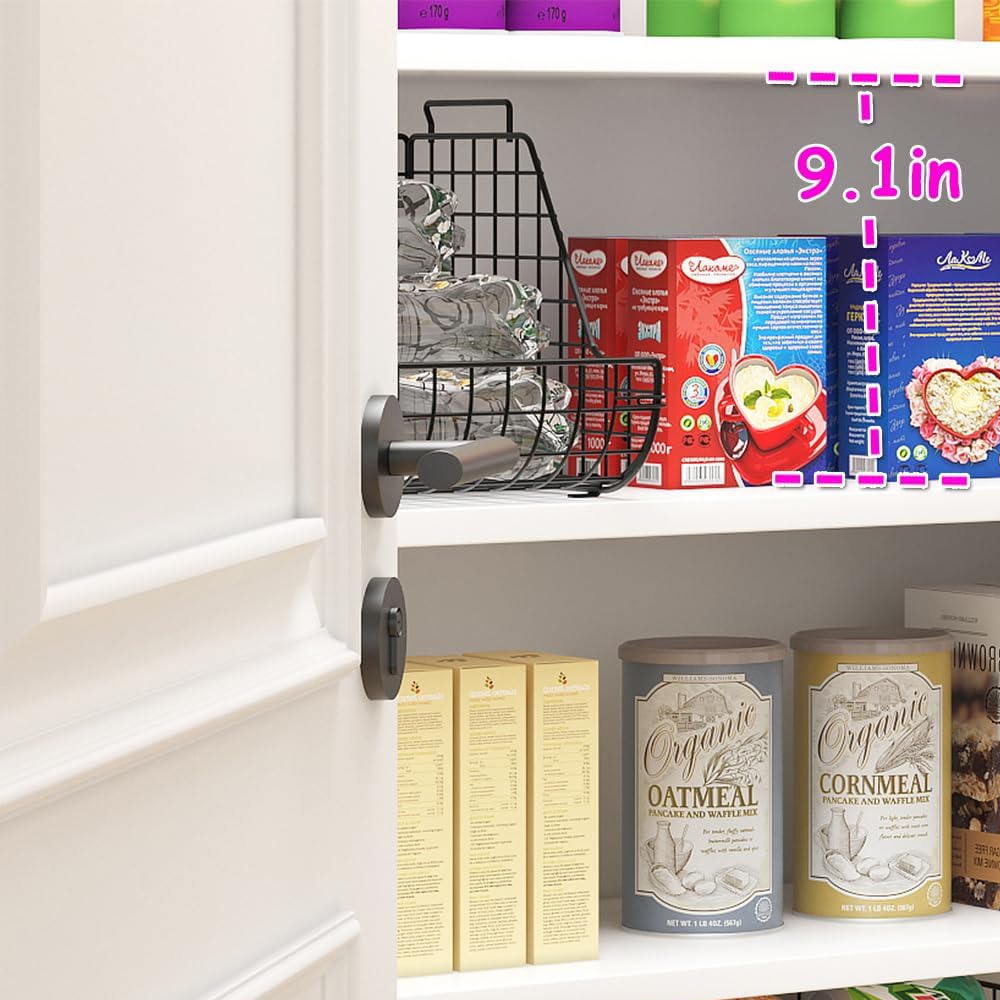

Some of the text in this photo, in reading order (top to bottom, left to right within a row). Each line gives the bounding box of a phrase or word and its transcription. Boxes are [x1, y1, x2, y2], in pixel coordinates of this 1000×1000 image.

[643, 700, 757, 781] Organic
[817, 690, 928, 769] Organic
[819, 773, 933, 795] CORNMEAL
[647, 784, 759, 808] OATMEAL
[822, 795, 930, 805] PANCAKE AND WAFFLE MIX
[648, 808, 758, 818] PANCAKE AND WAFFLE MIX
